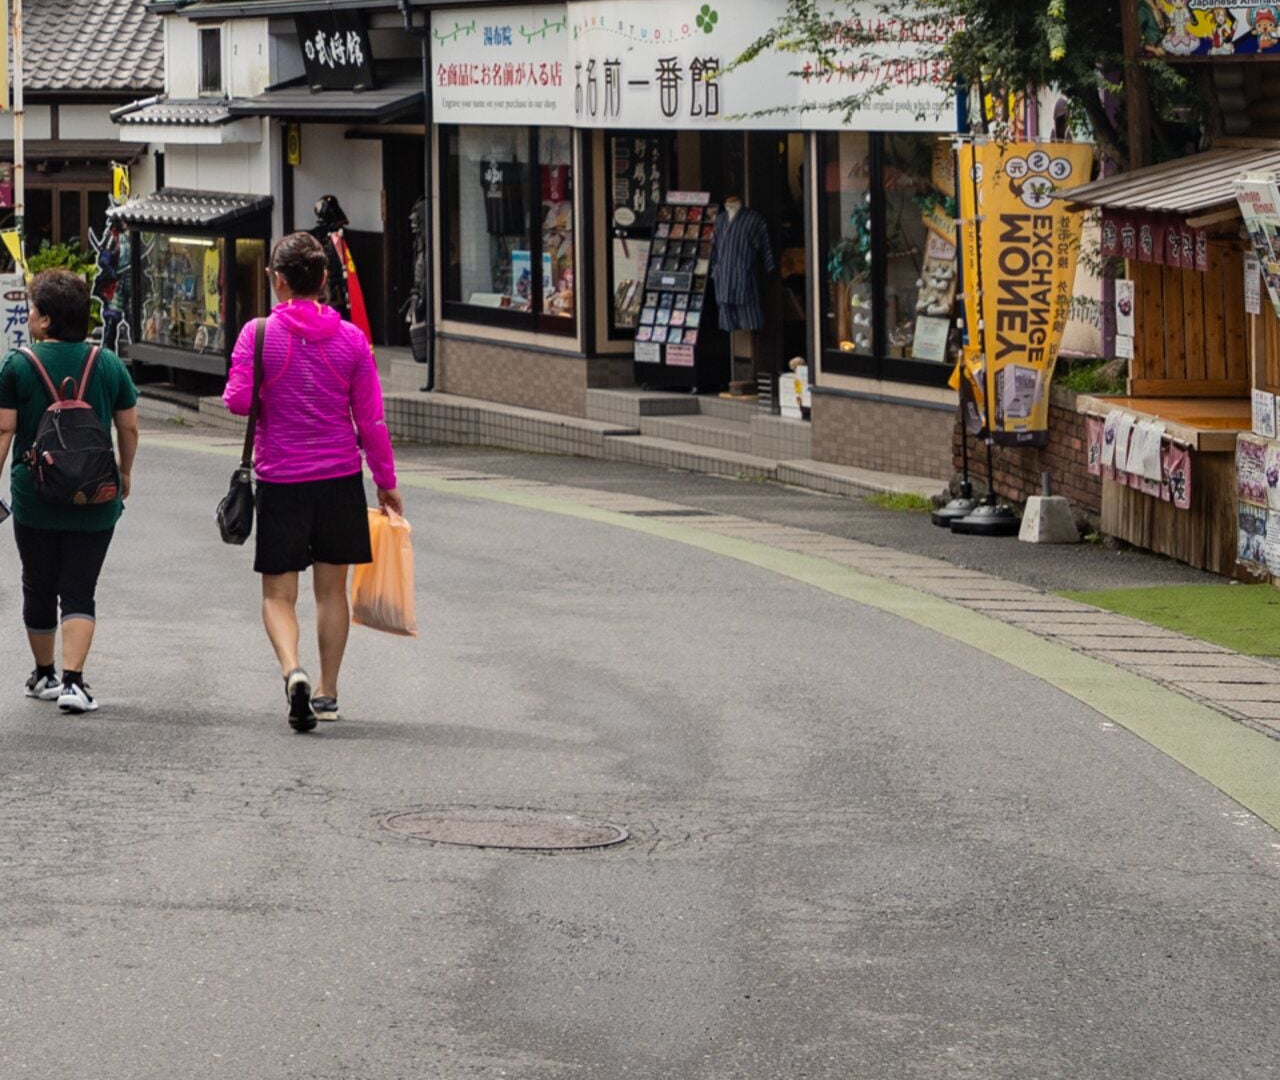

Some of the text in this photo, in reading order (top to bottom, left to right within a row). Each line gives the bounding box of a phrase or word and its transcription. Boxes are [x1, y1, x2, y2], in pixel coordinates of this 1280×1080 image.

[483, 26, 513, 47] 湯布院
[618, 21, 690, 40] STUDIO
[437, 62, 563, 88] 全商品にお名前が入る店
[575, 56, 719, 118] お名前一番館
